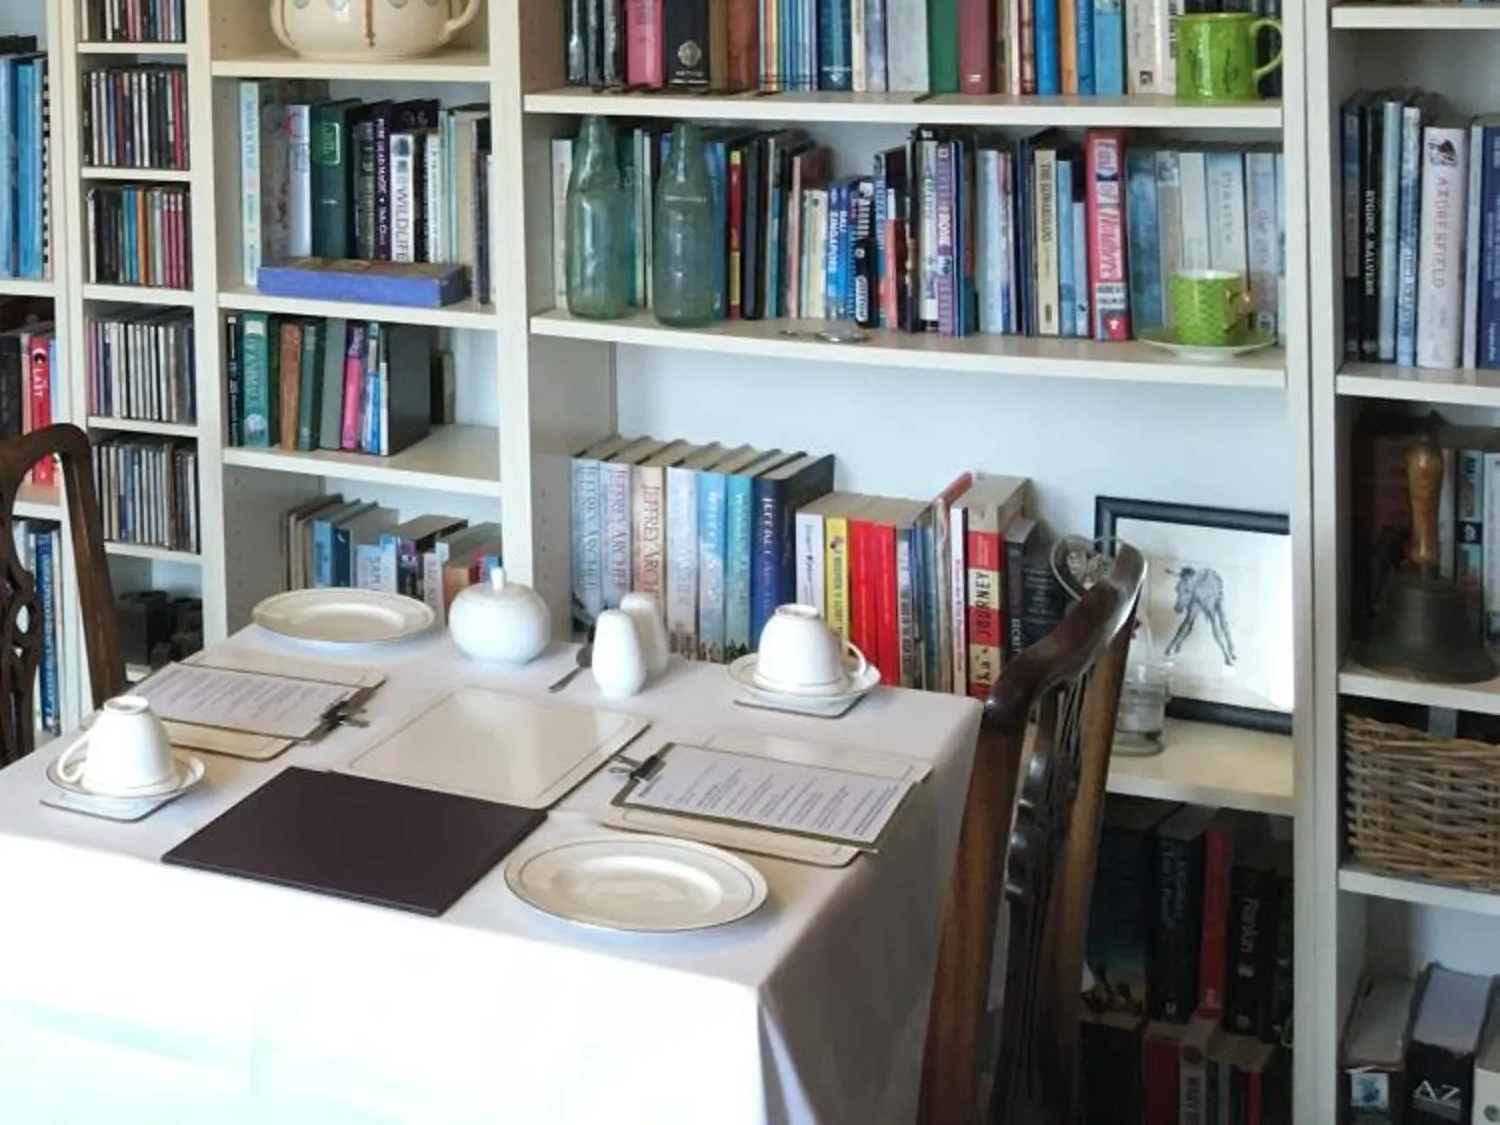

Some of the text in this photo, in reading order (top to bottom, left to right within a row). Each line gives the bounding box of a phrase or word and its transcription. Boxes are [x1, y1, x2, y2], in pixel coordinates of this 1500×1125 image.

[577, 465, 600, 590] JEFFREY ARCHER
[609, 469, 628, 527] JEFFREY
[642, 484, 661, 544] JEFFREY
[974, 571, 992, 638] JOURNEY
